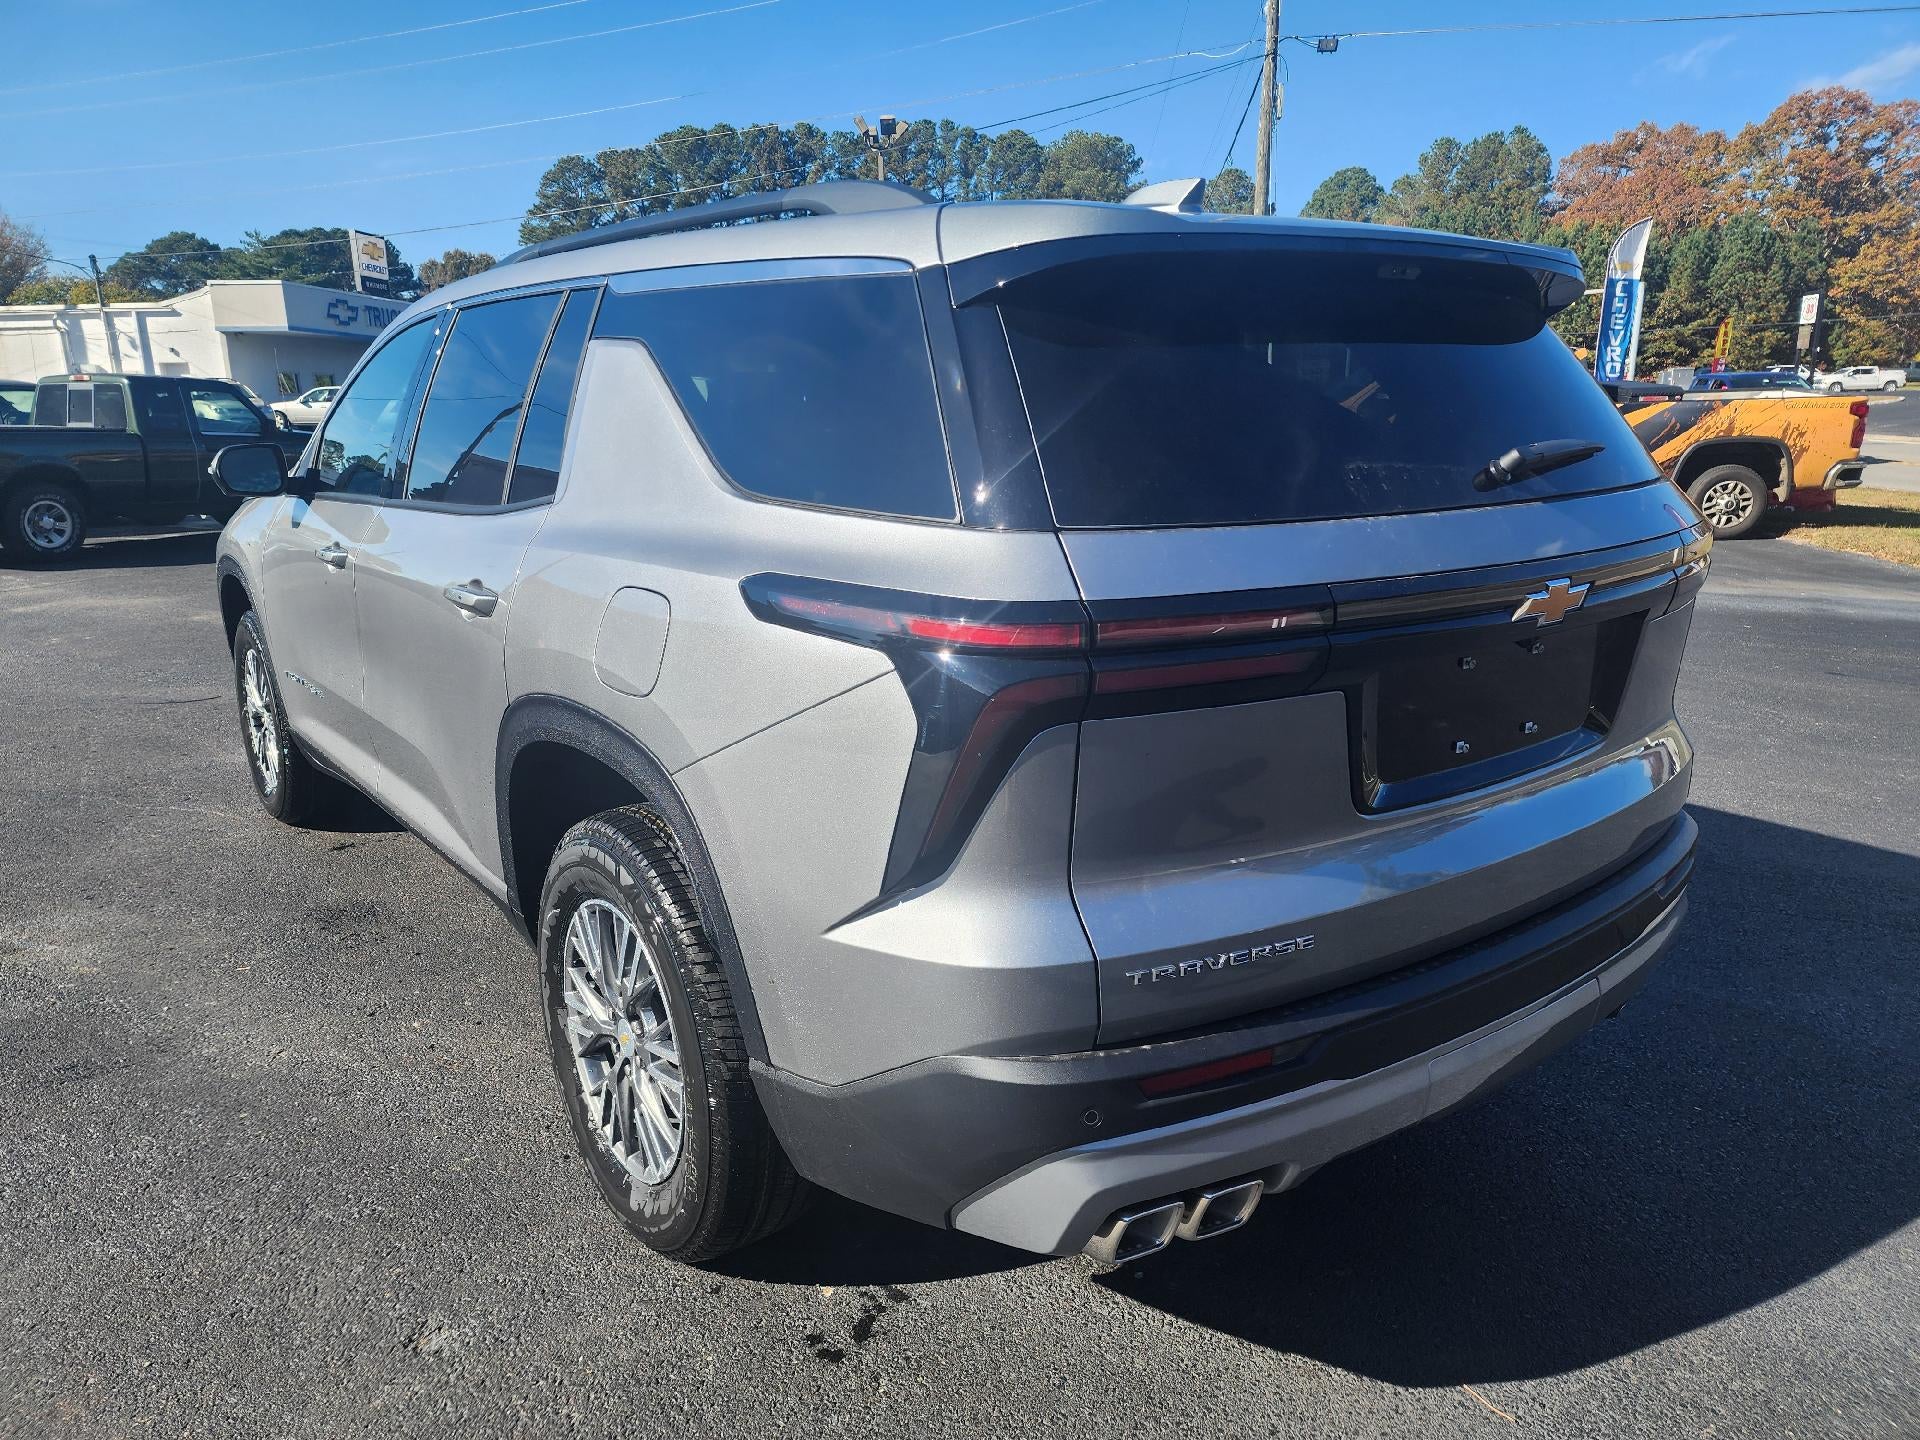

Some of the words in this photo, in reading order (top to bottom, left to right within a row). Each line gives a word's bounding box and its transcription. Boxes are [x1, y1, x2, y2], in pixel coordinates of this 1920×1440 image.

[362, 263, 387, 275] CHEVROLET
[364, 304, 401, 329] TRUC
[1605, 281, 1629, 381] CHEVRO
[1125, 934, 1315, 986] TRAVERSE
